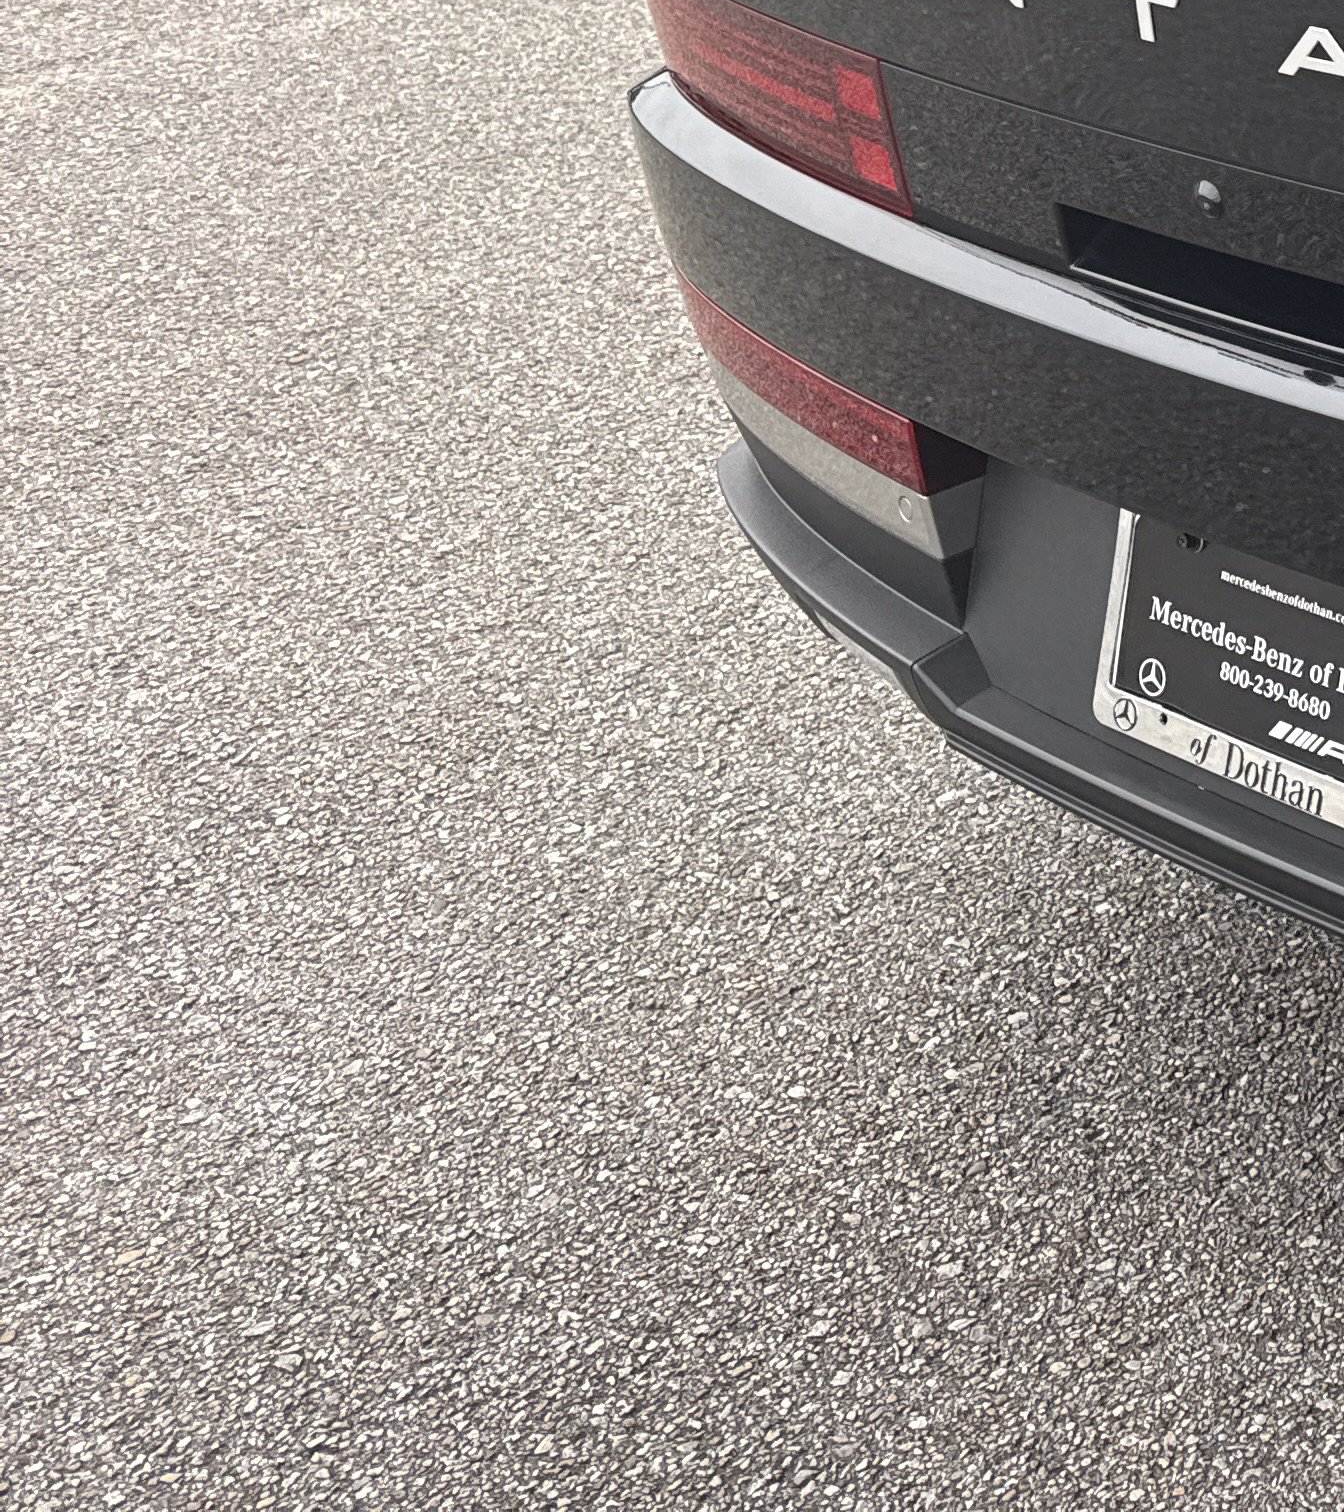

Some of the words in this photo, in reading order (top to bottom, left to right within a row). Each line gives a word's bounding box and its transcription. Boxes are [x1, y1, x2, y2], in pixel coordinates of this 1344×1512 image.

[1149, 596, 1304, 677] Mercedes-Benz
[1309, 662, 1335, 688] of
[1219, 661, 1331, 720] 800-239-8680
[1190, 734, 1217, 765] of
[1223, 741, 1325, 817] Dothan
